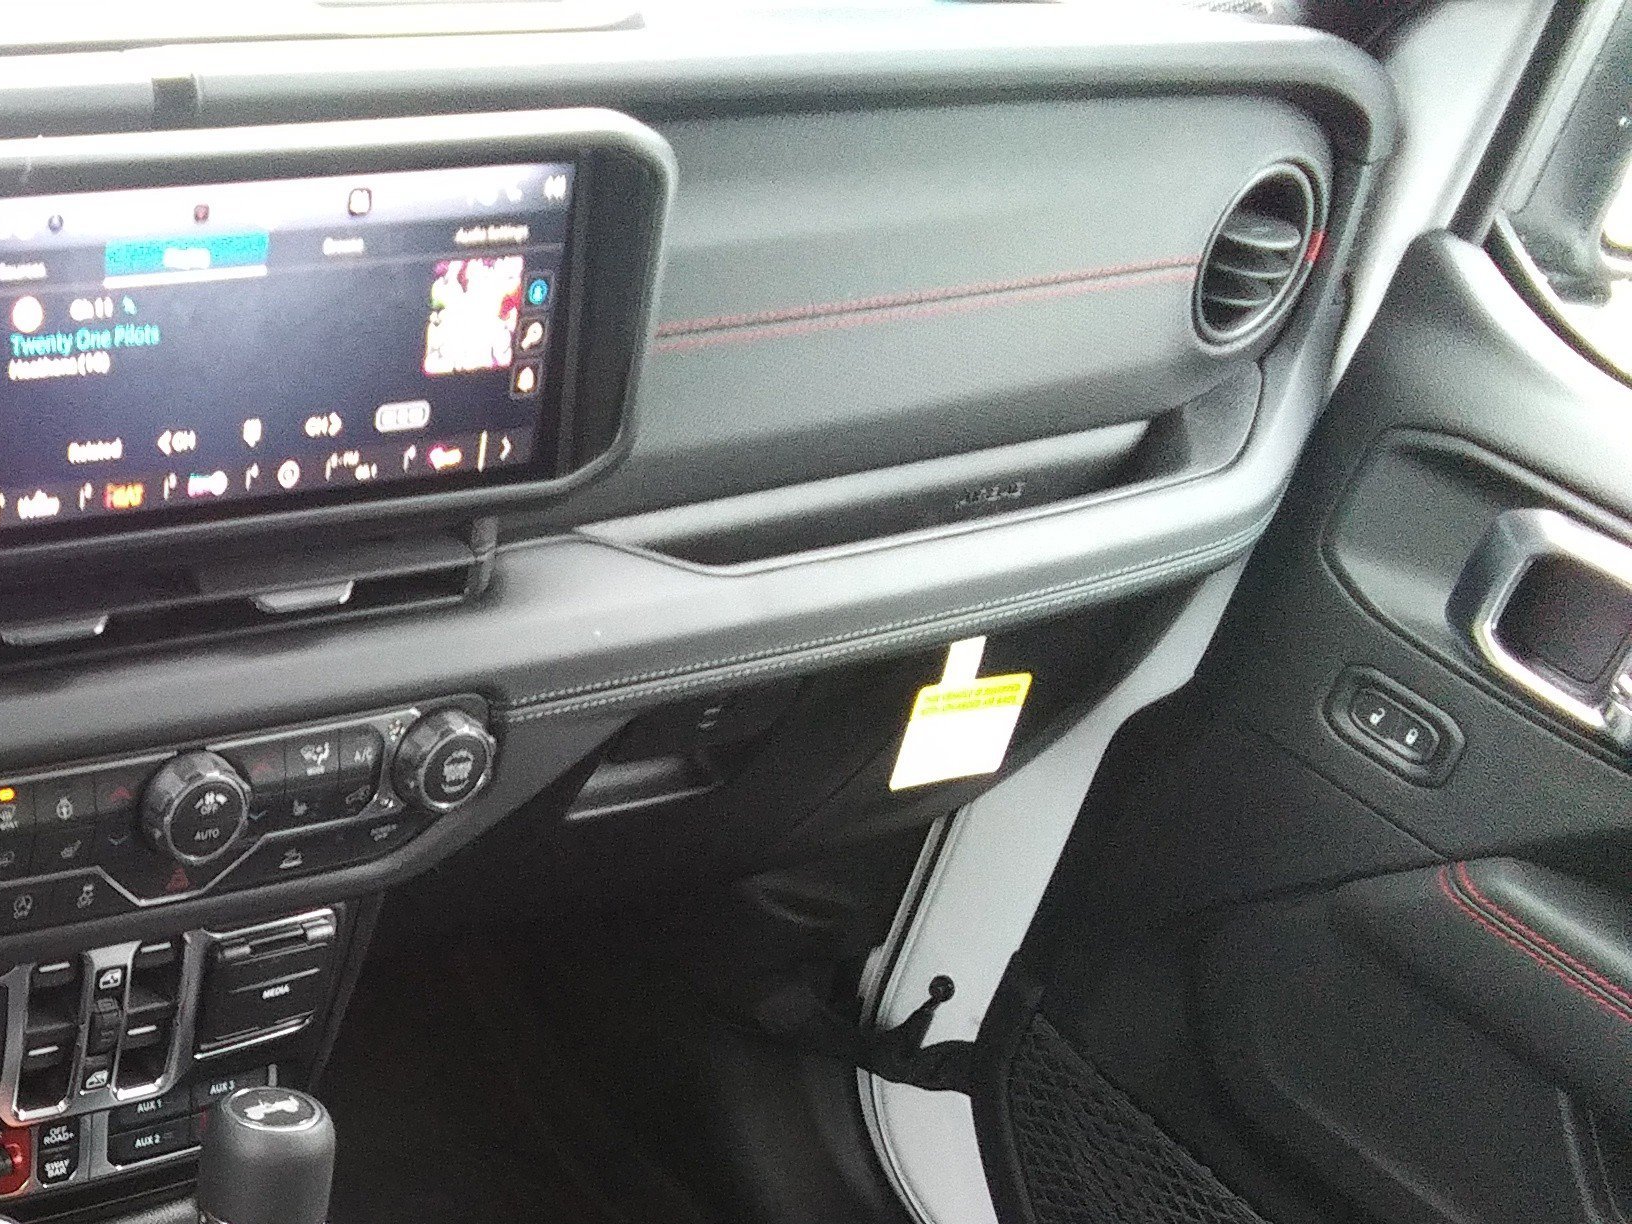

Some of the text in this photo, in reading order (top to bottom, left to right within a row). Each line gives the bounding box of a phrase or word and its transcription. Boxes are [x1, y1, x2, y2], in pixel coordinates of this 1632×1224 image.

[10, 323, 161, 356] Twenty One Pilots
[194, 827, 221, 841] AUTO
[261, 984, 291, 1000] MEDIA
[209, 1081, 229, 1096] AUX
[136, 1101, 156, 1114] AUX
[134, 1136, 154, 1149] AUX
